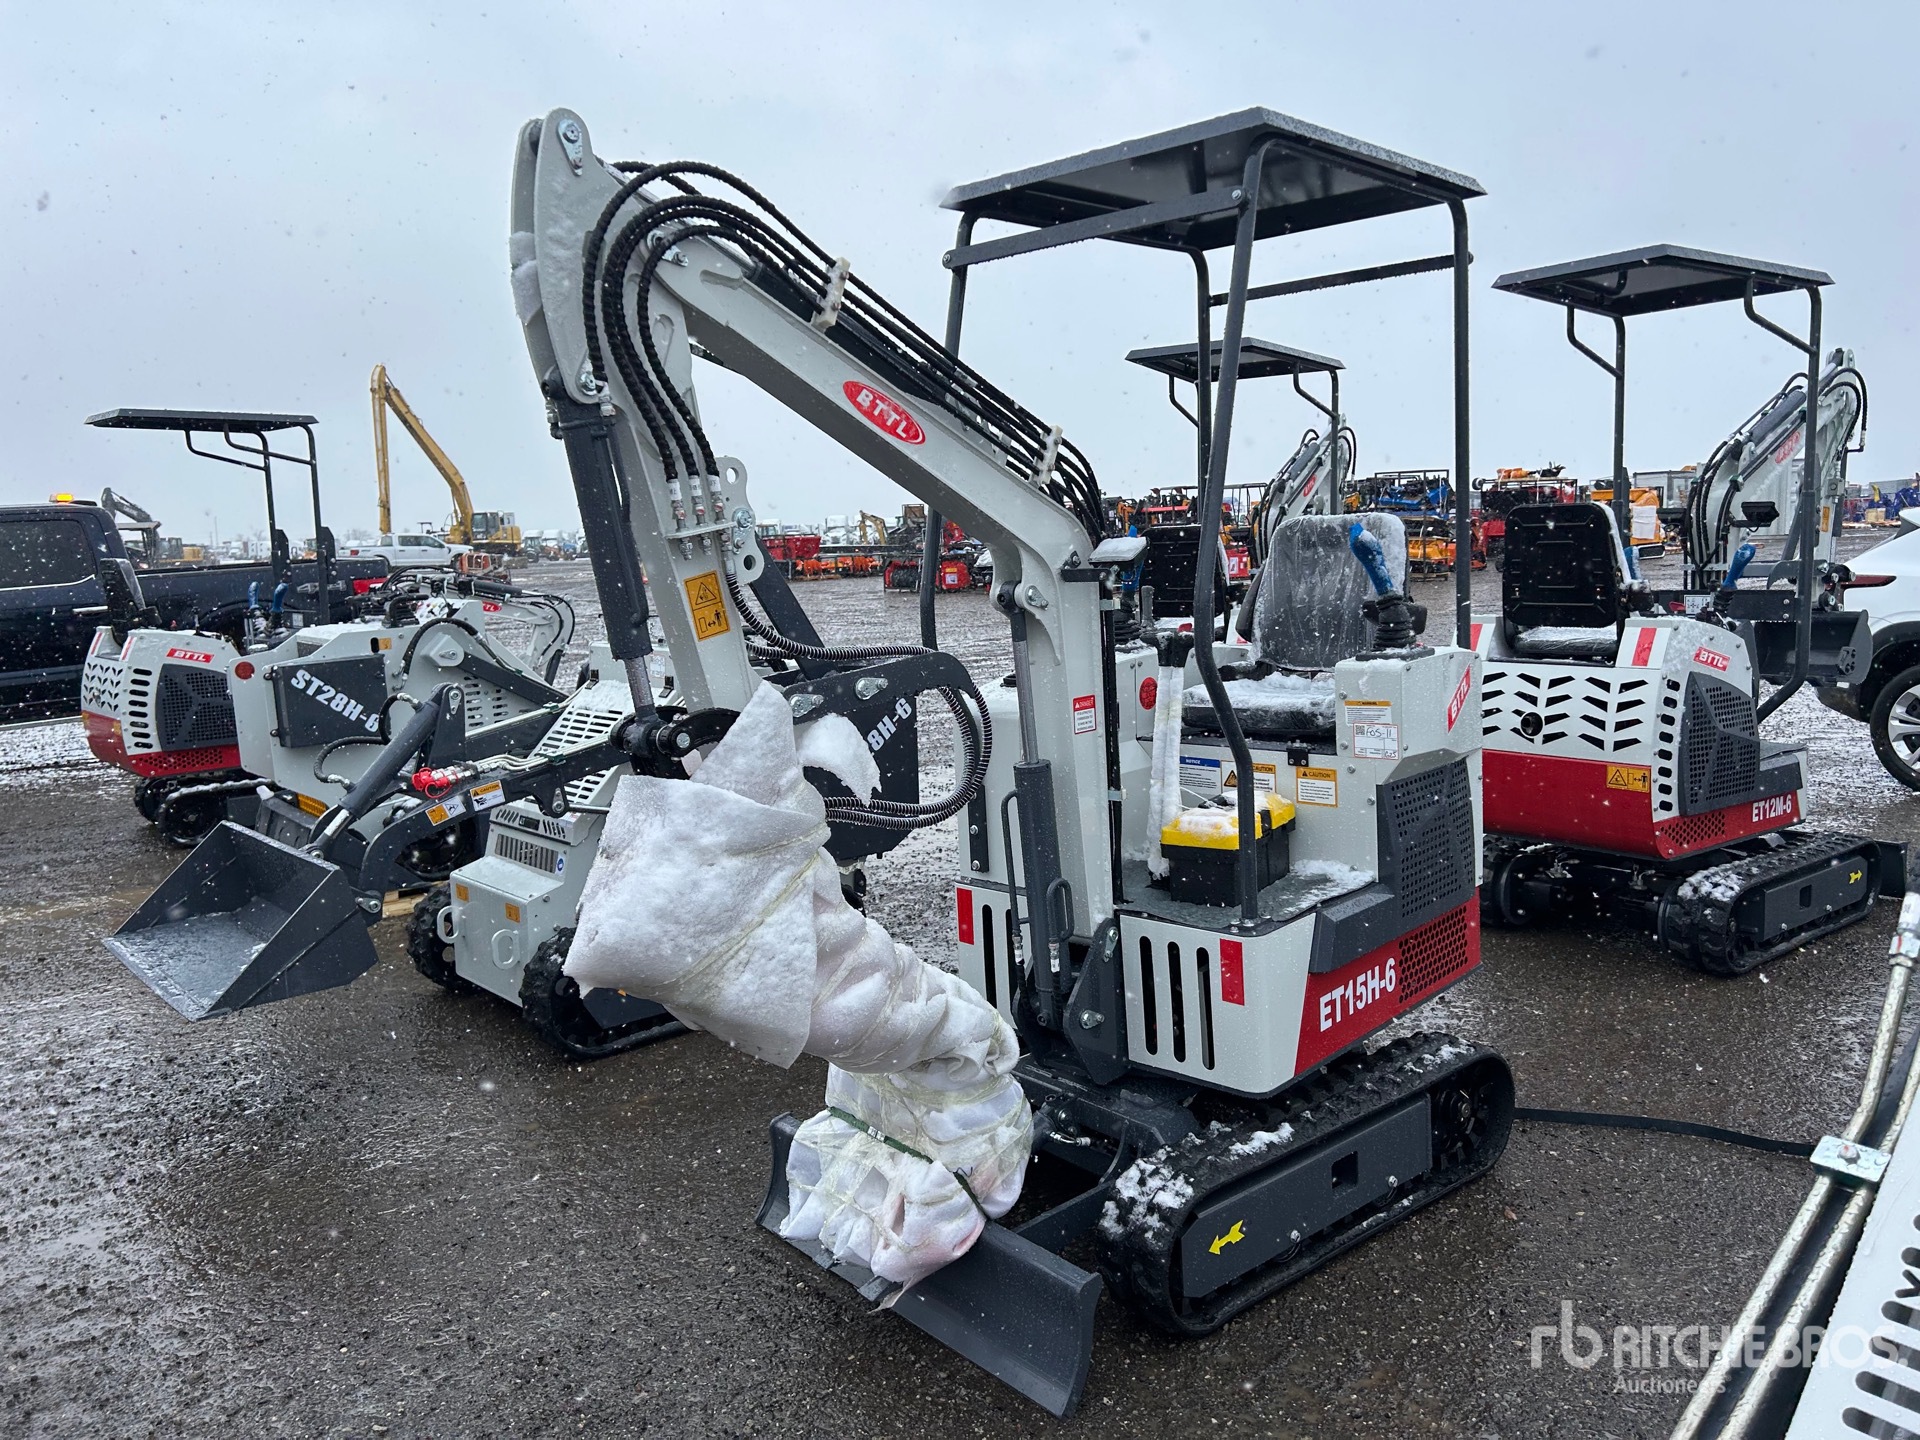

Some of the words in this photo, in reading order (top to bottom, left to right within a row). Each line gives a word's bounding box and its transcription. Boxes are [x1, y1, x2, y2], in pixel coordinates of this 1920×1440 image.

[856, 388, 907, 438] BTTL
[172, 650, 207, 661] BTTL
[1698, 650, 1724, 667] BTTL
[290, 669, 379, 733] ST28H-6
[1451, 676, 1469, 722] BTTL
[866, 697, 912, 751] 8H-6
[480, 783, 500, 793] CAUTION
[1309, 771, 1331, 779] CAUTION
[1752, 794, 1792, 823] ET12M-6
[1319, 957, 1396, 1033] ET15H-6
